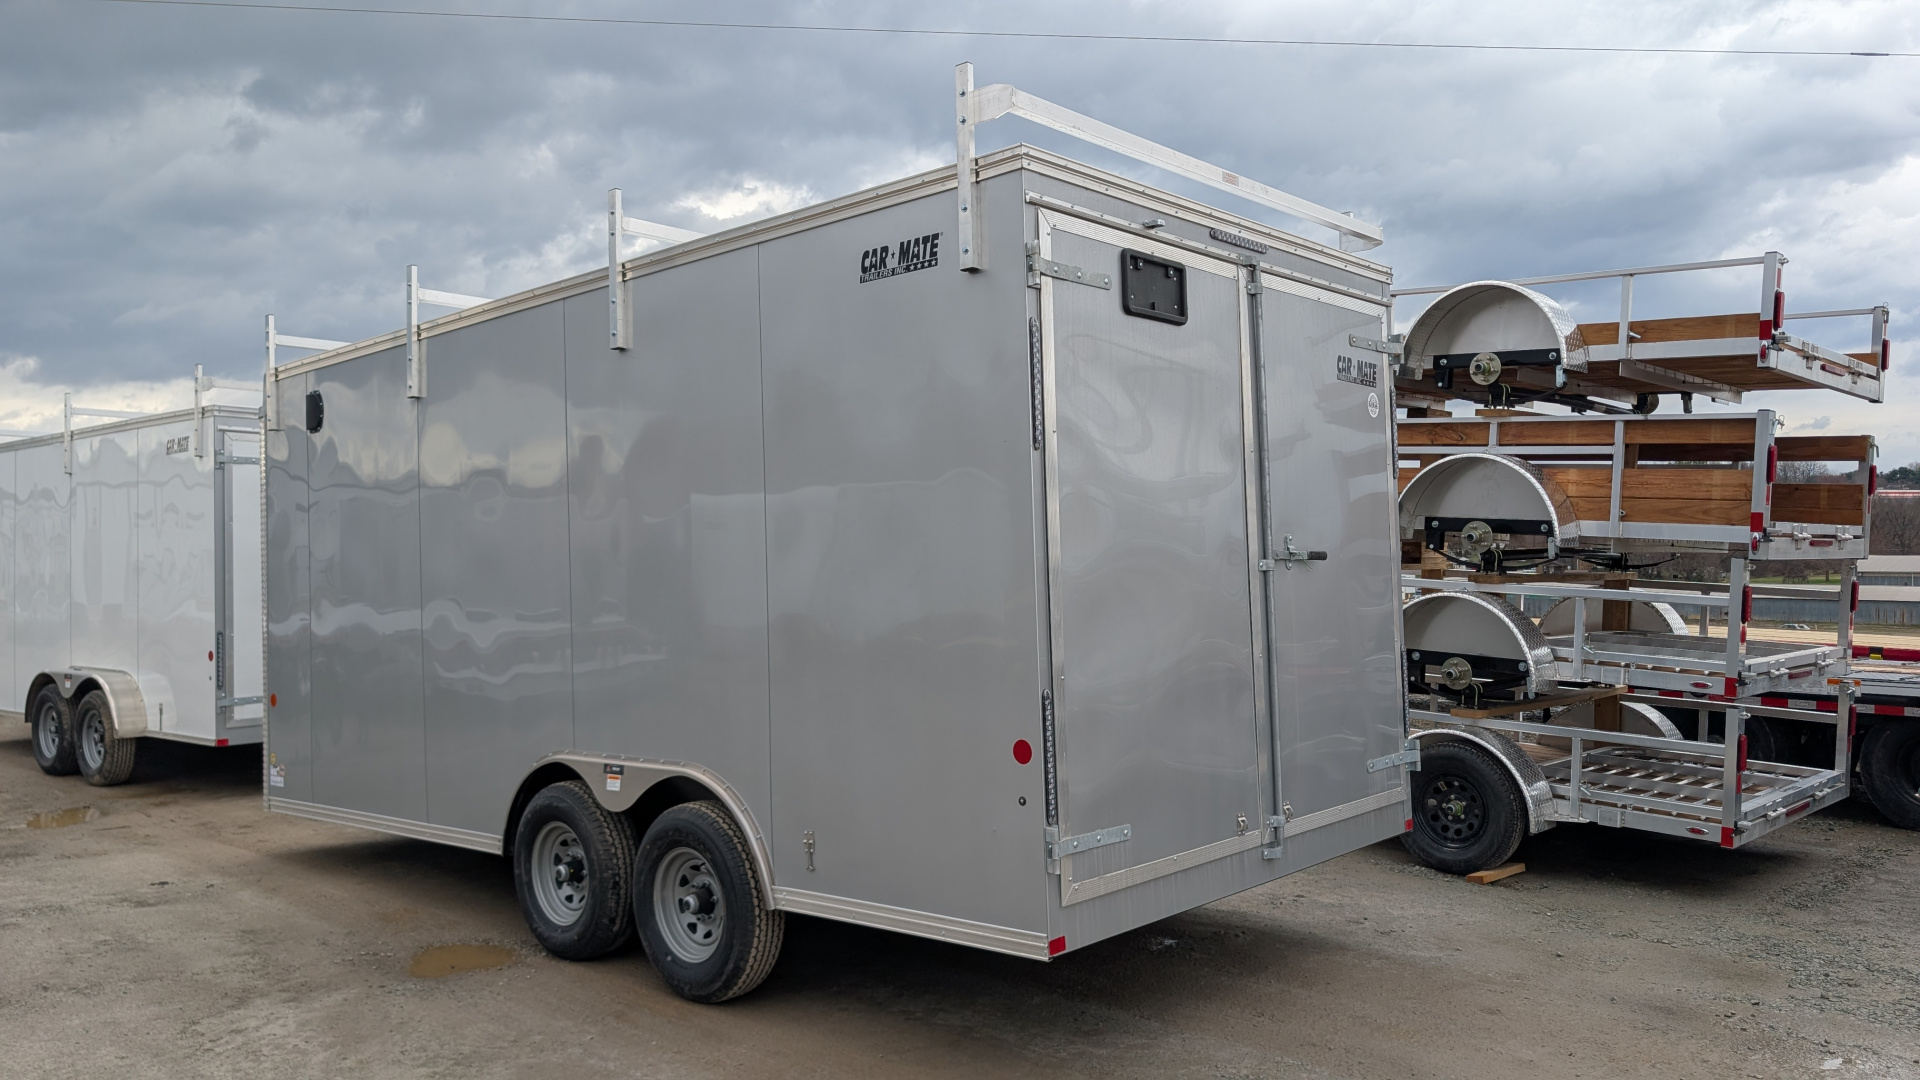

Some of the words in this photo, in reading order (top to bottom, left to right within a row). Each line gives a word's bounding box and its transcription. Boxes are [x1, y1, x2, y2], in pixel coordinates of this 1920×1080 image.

[861, 245, 889, 275] CAR
[898, 233, 940, 266] MATE
[861, 268, 893, 283] TRAILERS
[895, 264, 908, 275] INC.
[1337, 355, 1353, 376] CAR
[1357, 360, 1377, 382] MATE
